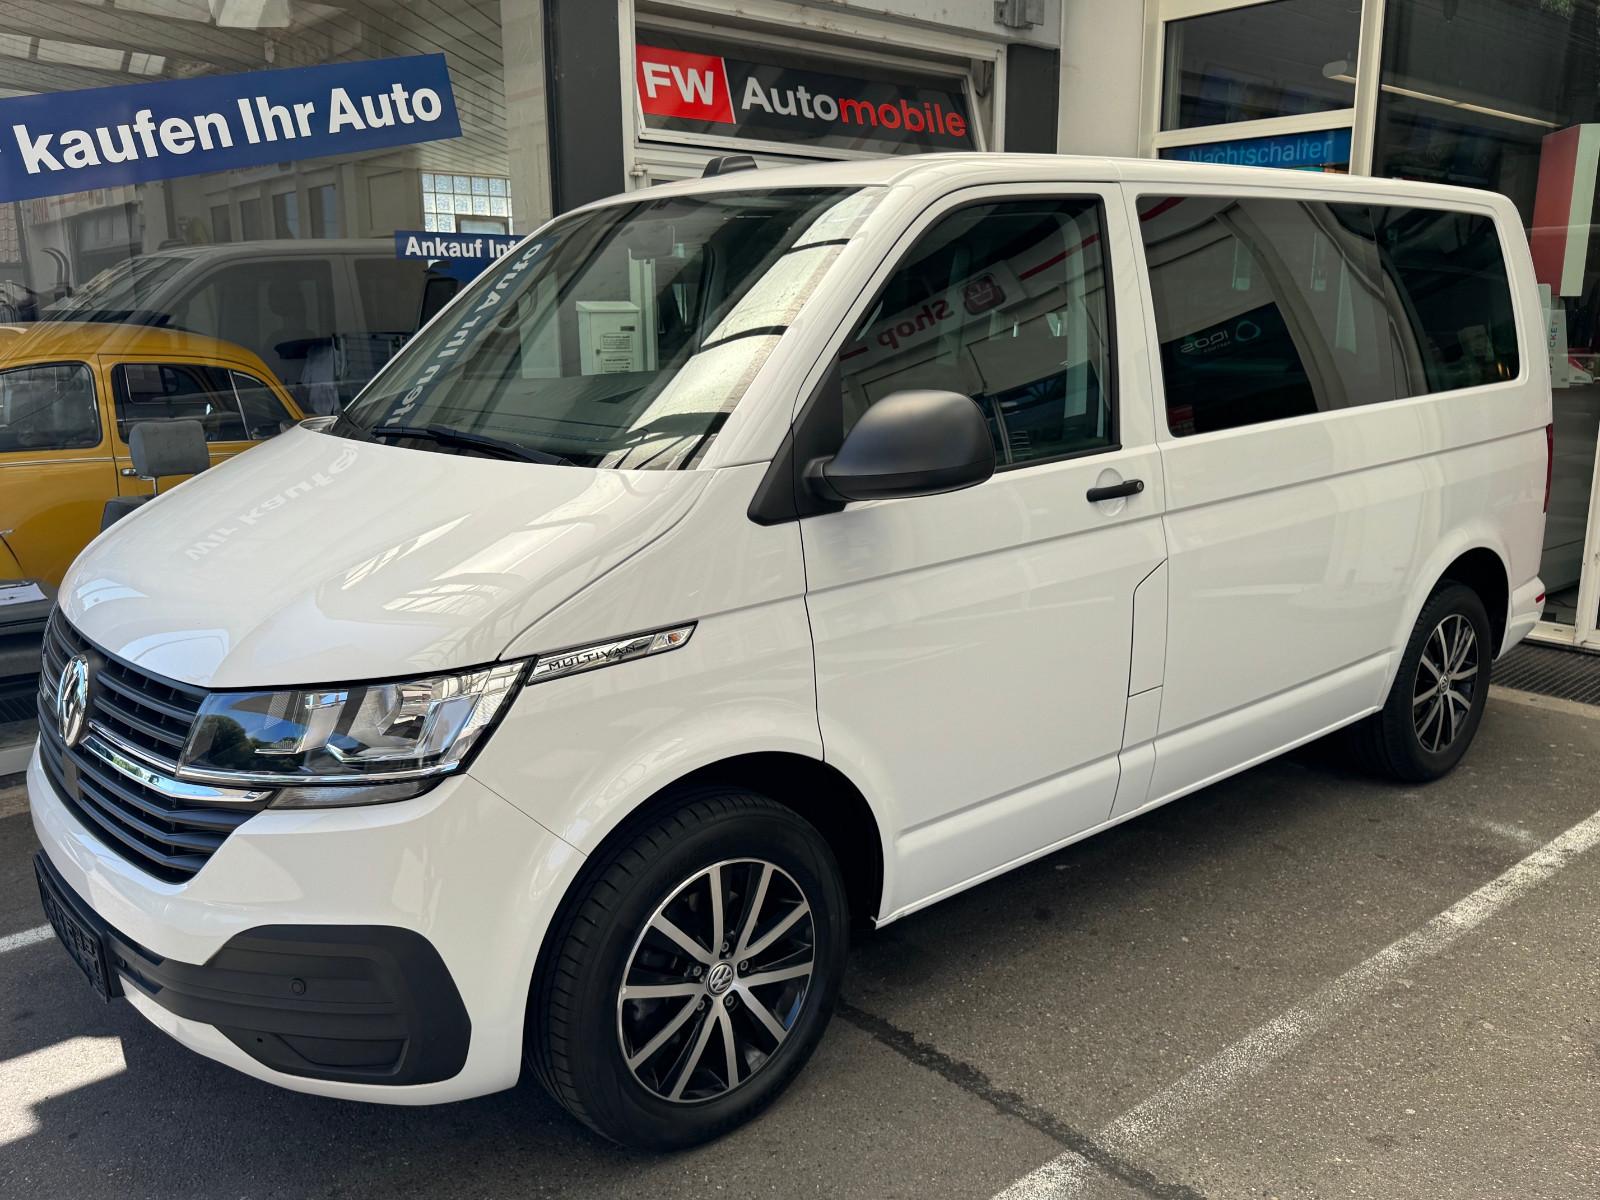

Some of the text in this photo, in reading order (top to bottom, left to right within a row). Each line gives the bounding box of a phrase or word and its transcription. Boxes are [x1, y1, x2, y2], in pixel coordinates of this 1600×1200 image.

[641, 60, 967, 138] FW Automobile
[13, 83, 443, 175] kaufen Ihr Auto
[405, 236, 483, 258] Ankauf
[549, 644, 637, 671] MULTIVAN
